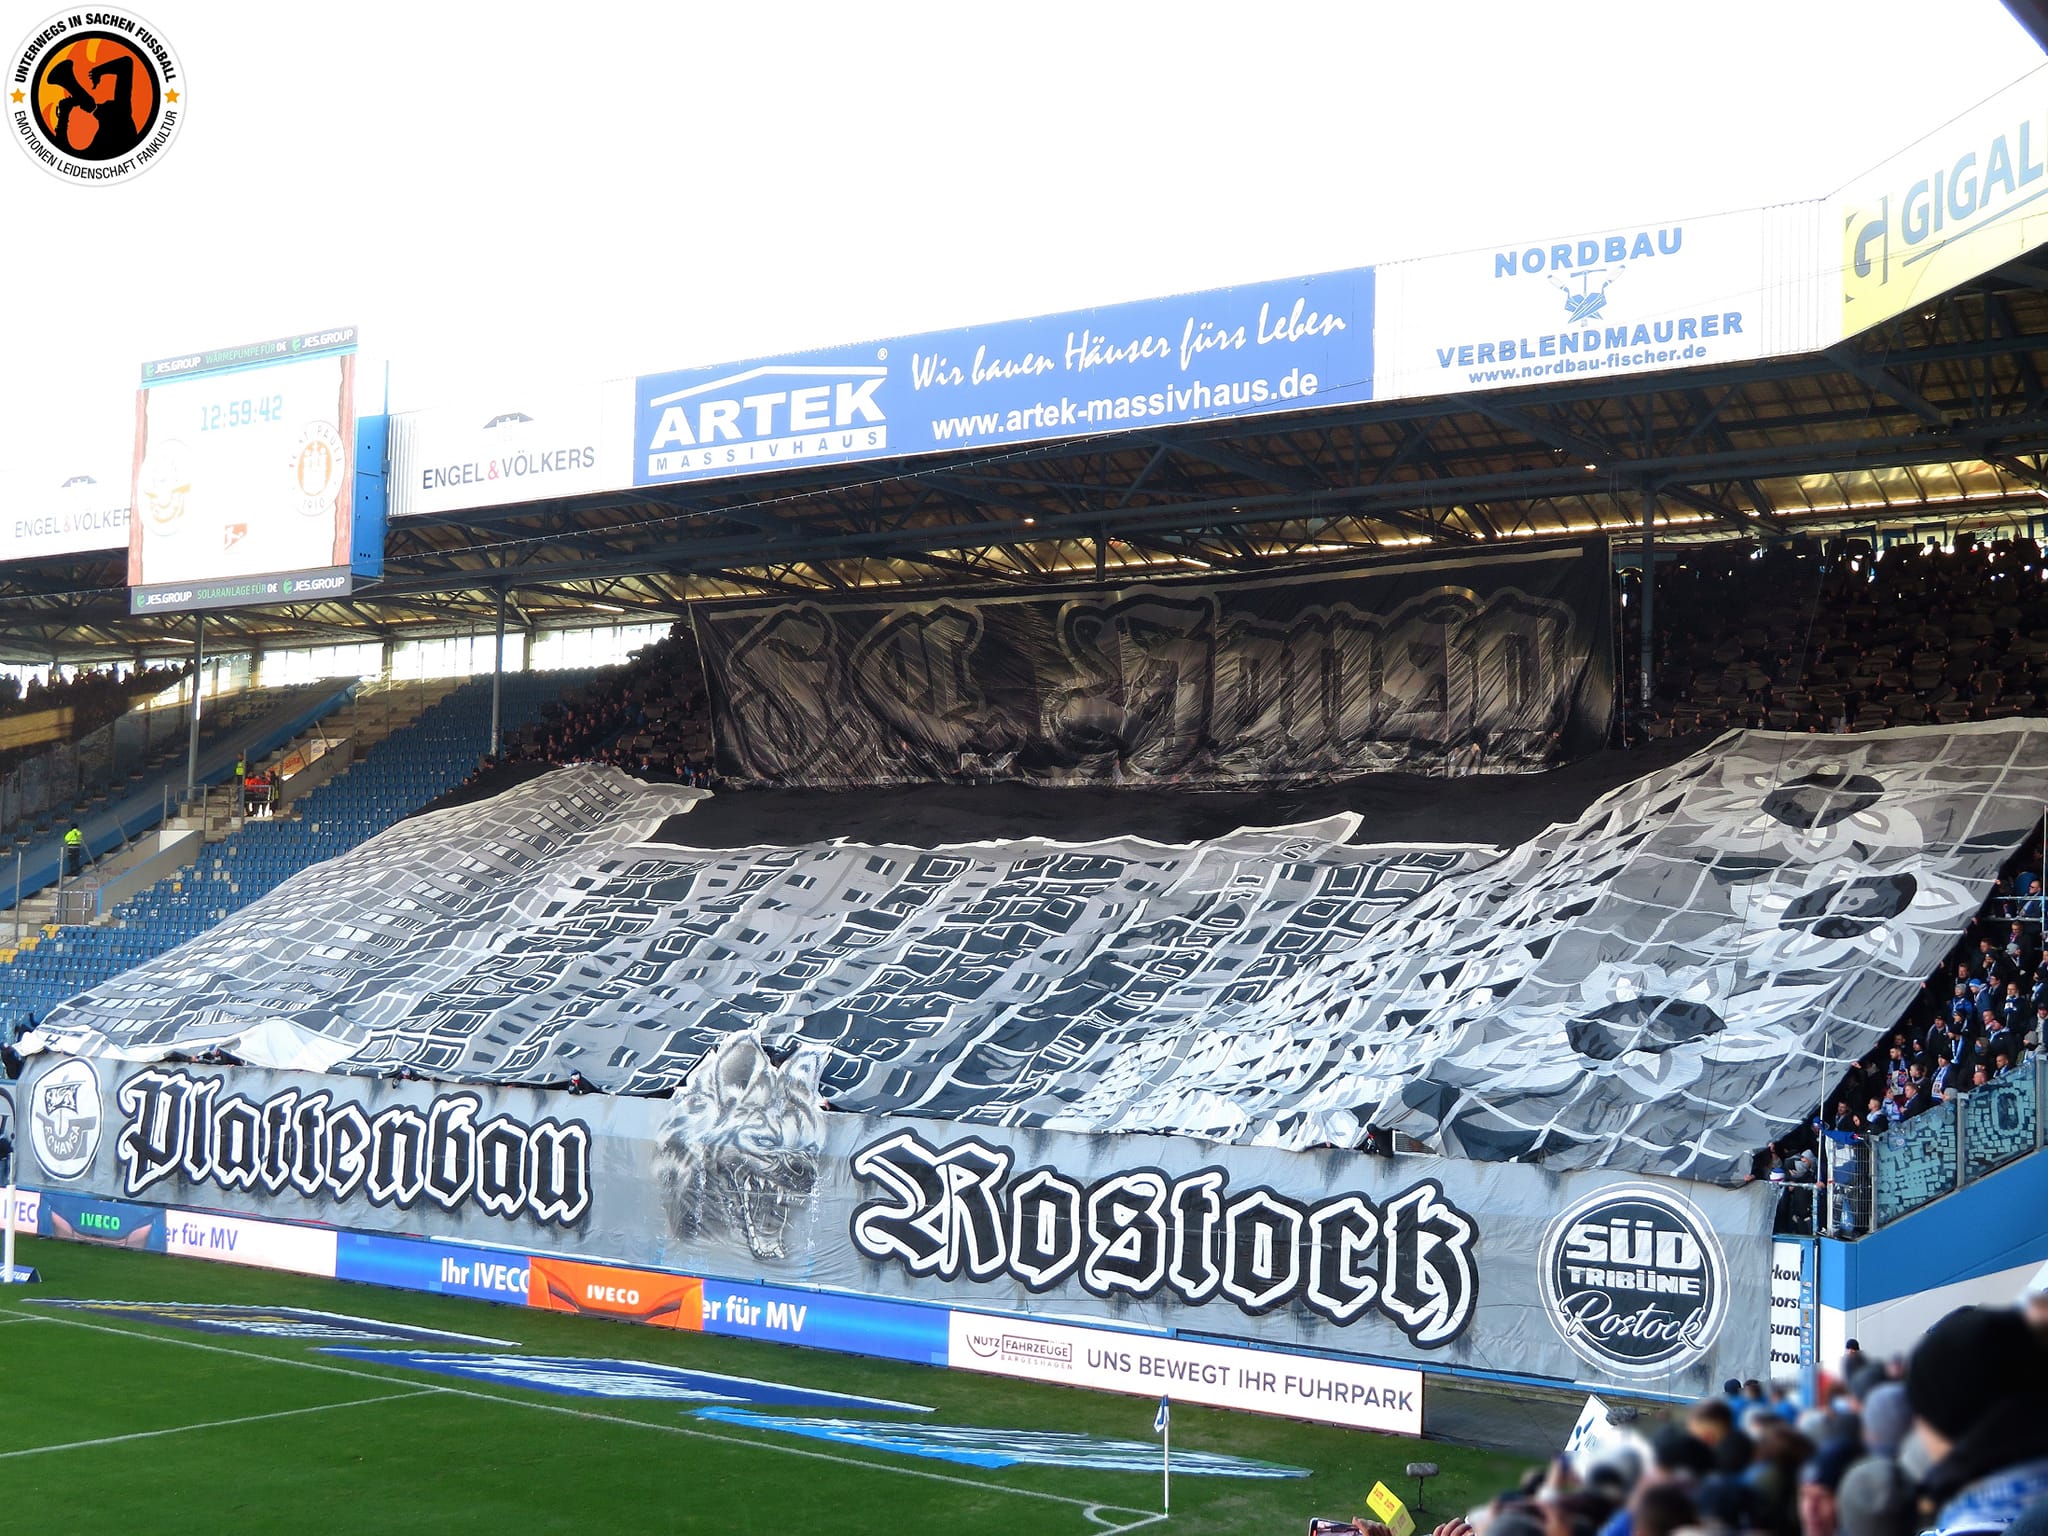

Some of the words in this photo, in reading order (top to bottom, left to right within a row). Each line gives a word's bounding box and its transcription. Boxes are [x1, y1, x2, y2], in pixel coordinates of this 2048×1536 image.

[1901, 112, 2048, 246] GIGAL
[1494, 227, 1682, 278] NORDBAU
[155, 356, 201, 374] JES.GROUP
[302, 329, 353, 348] JES.GROUP
[911, 353, 965, 391] Wir
[971, 344, 1055, 381] bauen
[1065, 328, 1171, 373] Häuser
[1180, 316, 1247, 371] fürs
[1257, 297, 1346, 345] Leben
[1436, 311, 1743, 368] VERBLENDMAURER
[1468, 344, 1707, 384] www.nordbau-fischer.de
[201, 393, 282, 431] 12:59:42
[649, 377, 887, 450] ARTEK
[932, 367, 1318, 441] www.artek-massivhaus.de
[656, 431, 878, 471] MASSIVHAUS
[145, 591, 192, 605] JES.GROUP
[197, 585, 250, 600] SOLARANLAGE
[252, 582, 266, 595] FÜR
[267, 582, 278, 593] 0€
[293, 577, 345, 591] JES.GROUP
[54, 1126, 80, 1154] HANSA
[116, 1065, 593, 1228] Plattenbau
[80, 1212, 120, 1230] IVECO
[182, 1222, 206, 1247] für
[210, 1226, 239, 1251] MV
[848, 1126, 1479, 1349] Rostock
[1565, 1218, 1701, 1271] SÜD
[441, 1257, 470, 1285] Ihr
[1566, 1265, 1701, 1296] TRIBÜNE
[586, 1283, 640, 1305] IVECO
[726, 1294, 761, 1326] für
[766, 1300, 808, 1333] MV
[1559, 1289, 1706, 1351] Rostock
[973, 1335, 1000, 1348] NUTZ
[1005, 1340, 1069, 1357] FAHRZEUGE
[1087, 1348, 1132, 1373] UNS
[1139, 1355, 1231, 1386] BEWEGT
[1239, 1368, 1276, 1393] IHR
[1285, 1375, 1413, 1412] FUHRPARK
